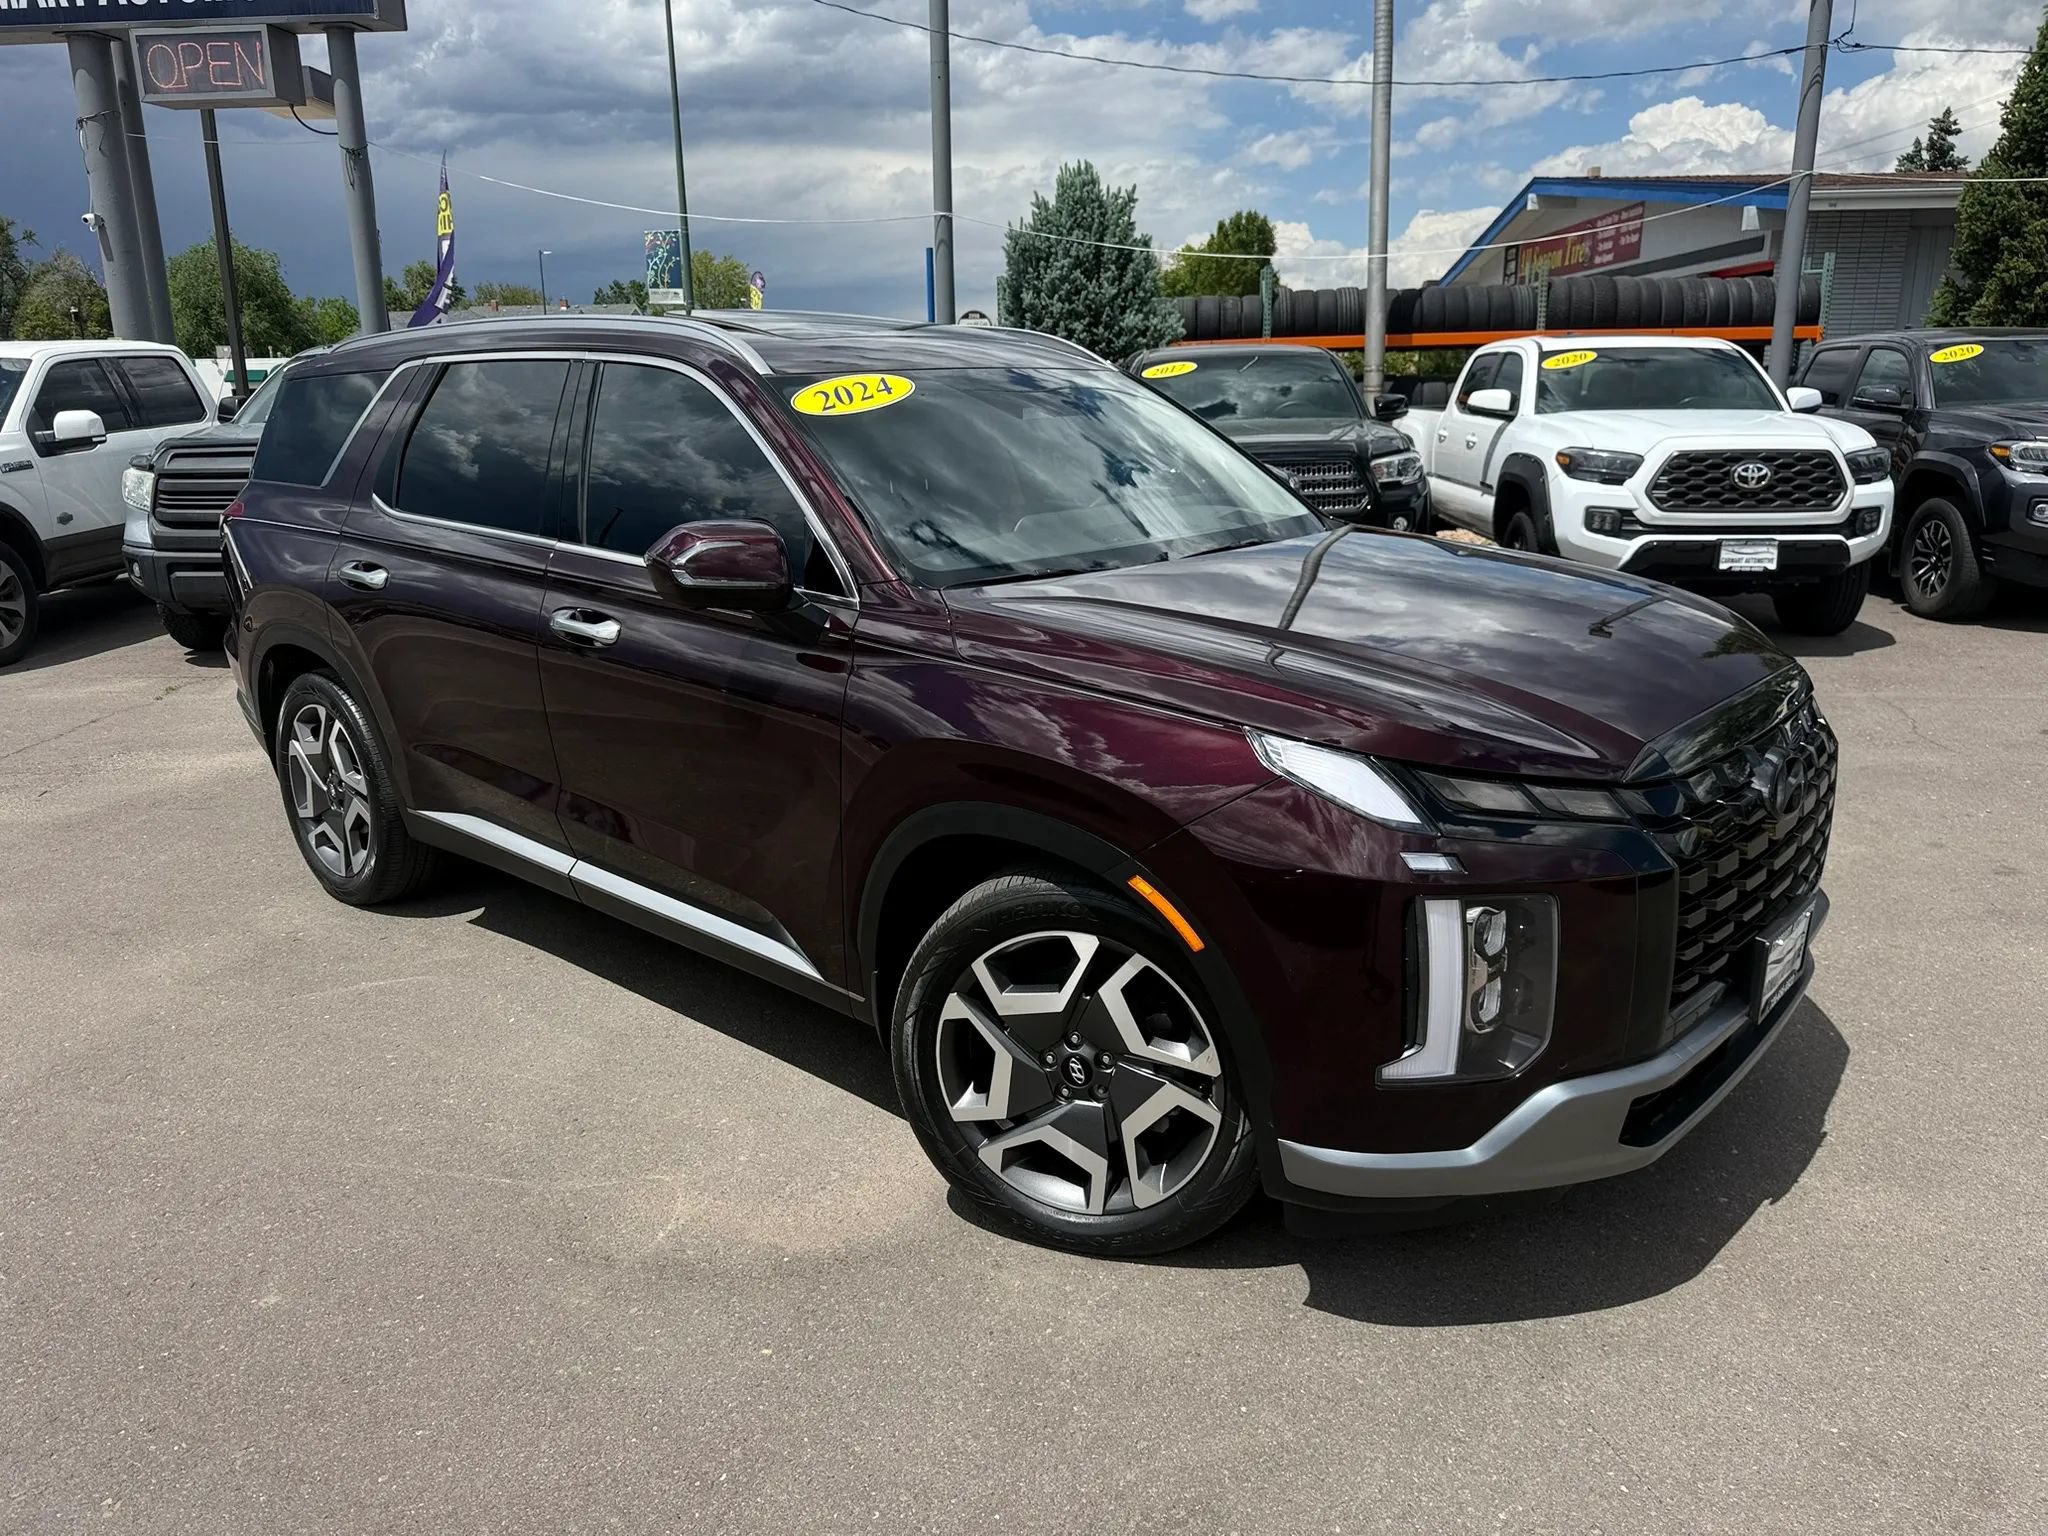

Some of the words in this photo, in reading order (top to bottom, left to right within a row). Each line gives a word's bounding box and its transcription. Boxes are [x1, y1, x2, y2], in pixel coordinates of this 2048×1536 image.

[146, 41, 265, 89] OPEN
[1553, 352, 1587, 367] 2020
[1941, 345, 1975, 360] 2020
[1151, 363, 1187, 376] 2017
[813, 376, 893, 412] 2024
